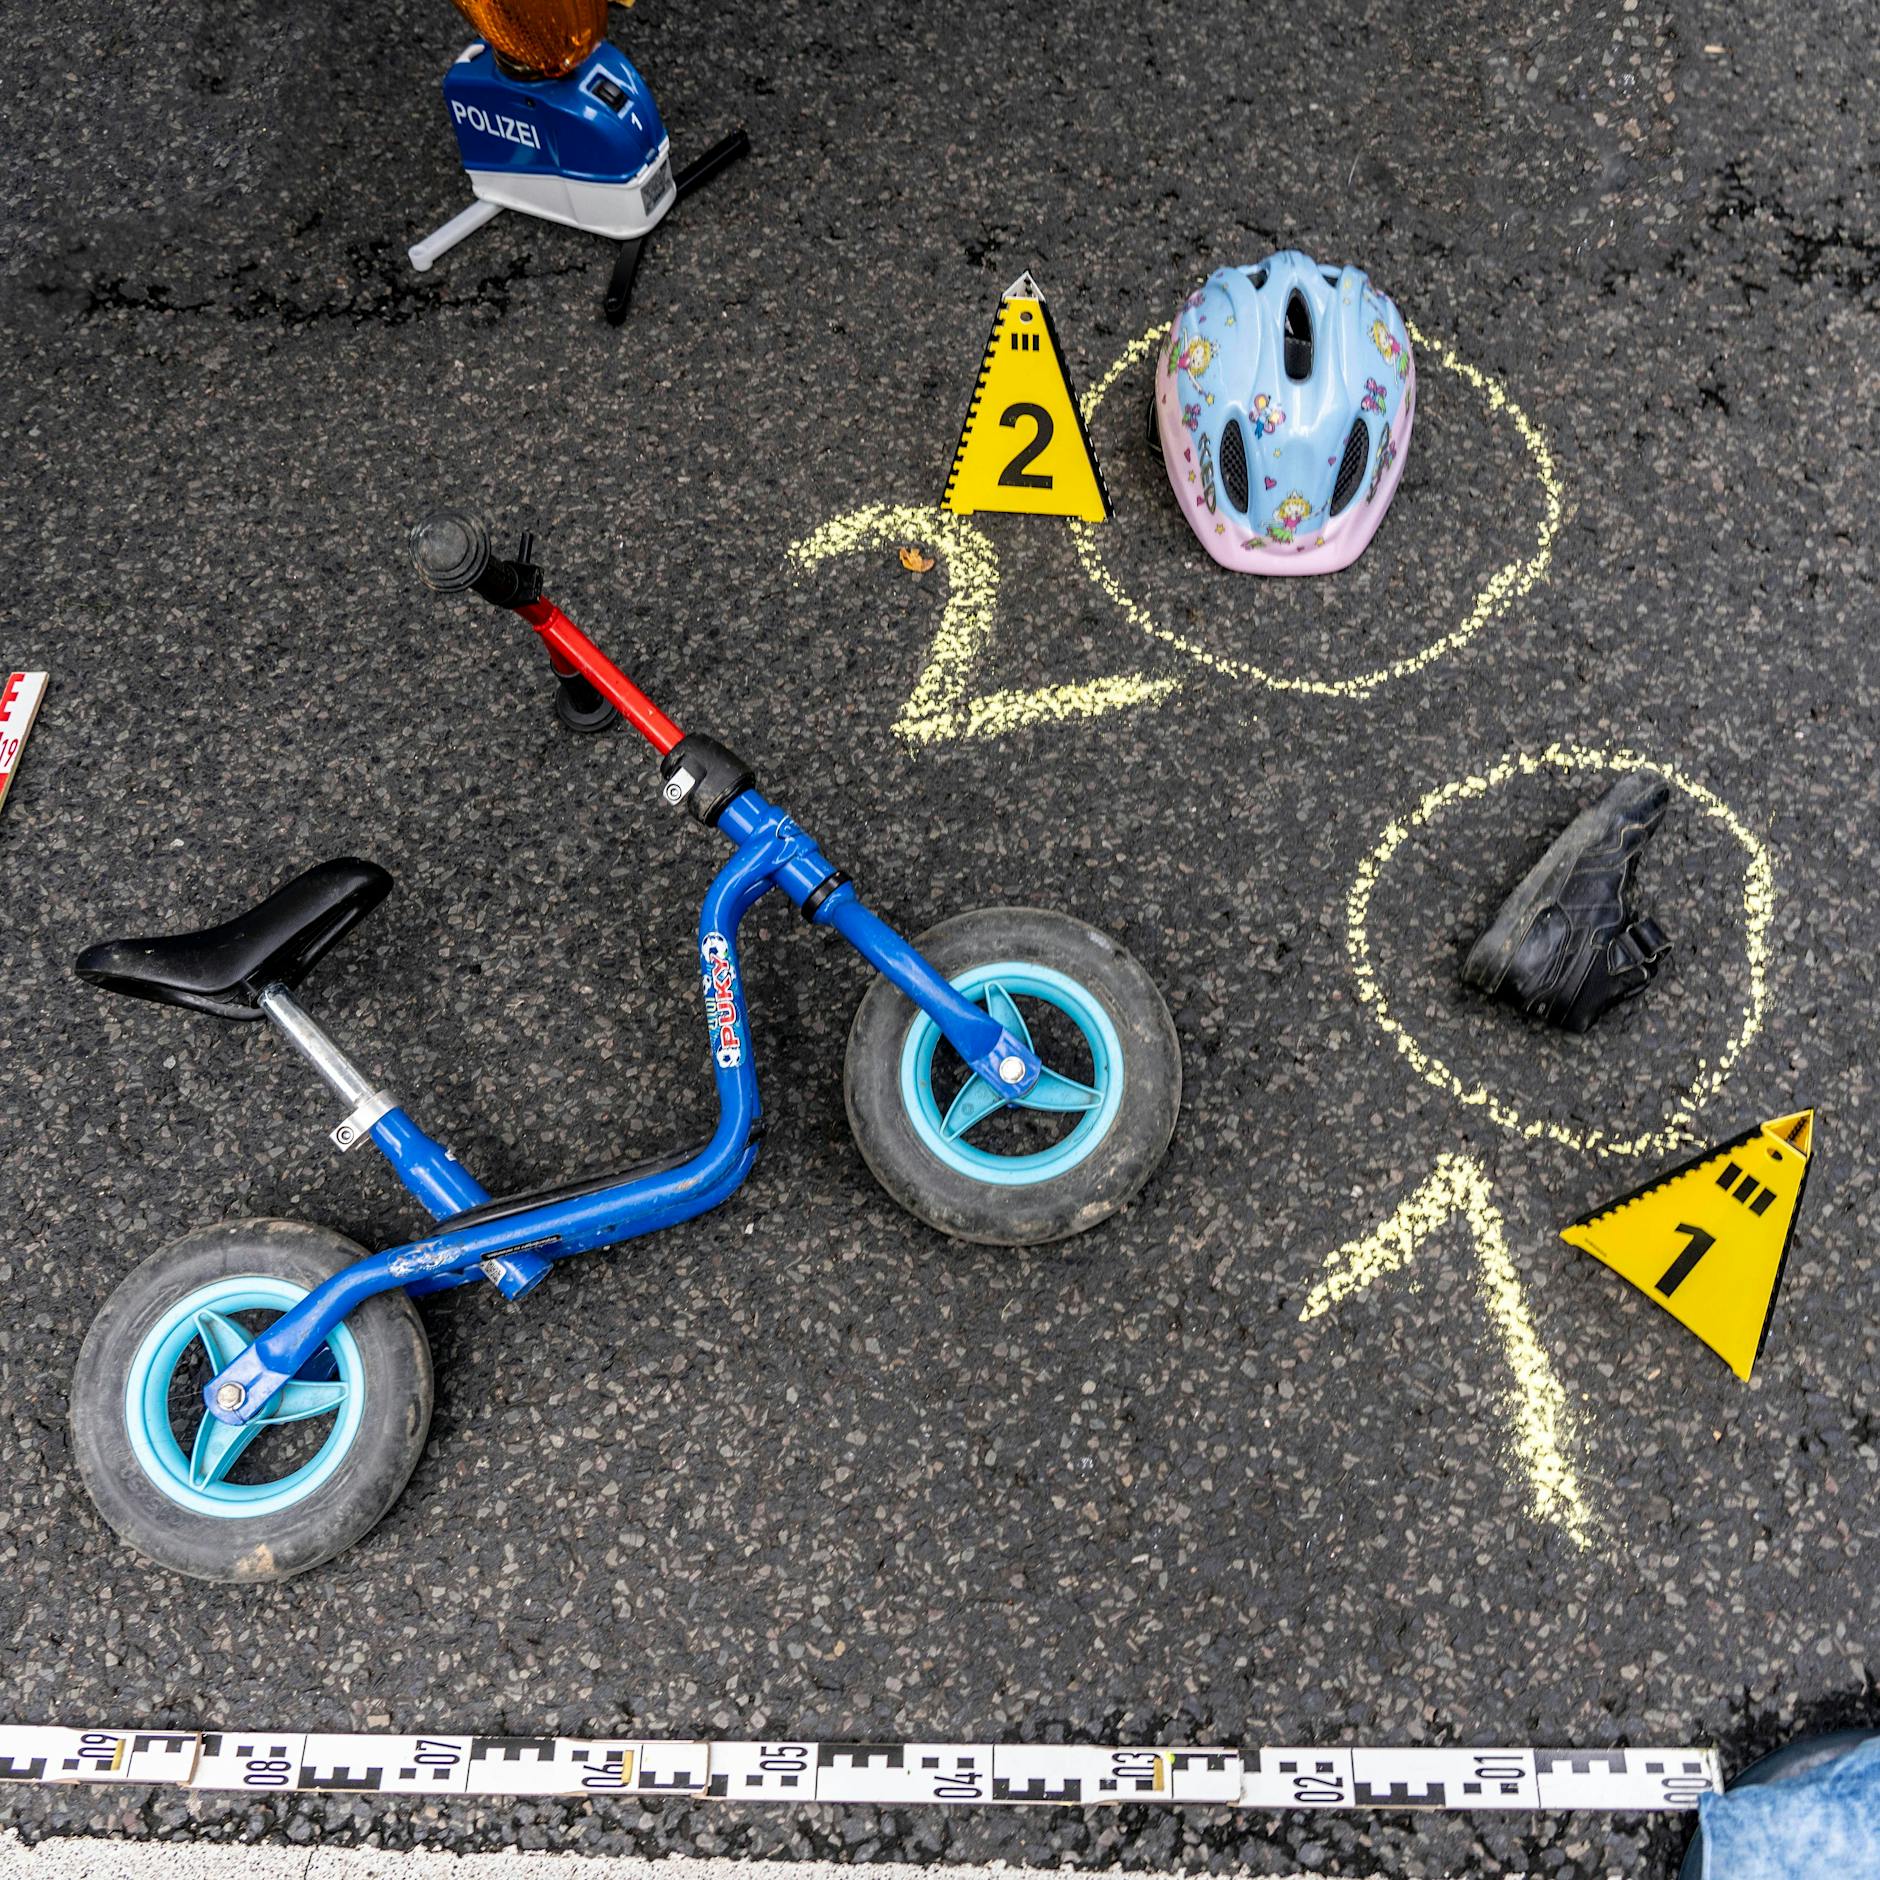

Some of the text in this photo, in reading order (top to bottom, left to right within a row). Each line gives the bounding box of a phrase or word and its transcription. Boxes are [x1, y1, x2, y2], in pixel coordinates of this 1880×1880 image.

[451, 99, 541, 150] POLIZEI
[631, 113, 643, 131] 1
[997, 402, 1055, 490] 2
[784, 502, 1183, 745] 2
[711, 955, 740, 1050] PUKY
[1654, 1222, 1716, 1299] 1
[1298, 1152, 1594, 1550] 1
[77, 1733, 121, 1760] 09
[413, 1739, 463, 1767] 07
[759, 1745, 809, 1772] 05
[243, 1760, 292, 1787] 08
[581, 1764, 629, 1788] 06
[1111, 1752, 1162, 1779] 03
[1473, 1756, 1526, 1780] 01
[933, 1771, 983, 1799] 04
[1293, 1776, 1344, 1803] 02
[1661, 1777, 1713, 1803] 00
